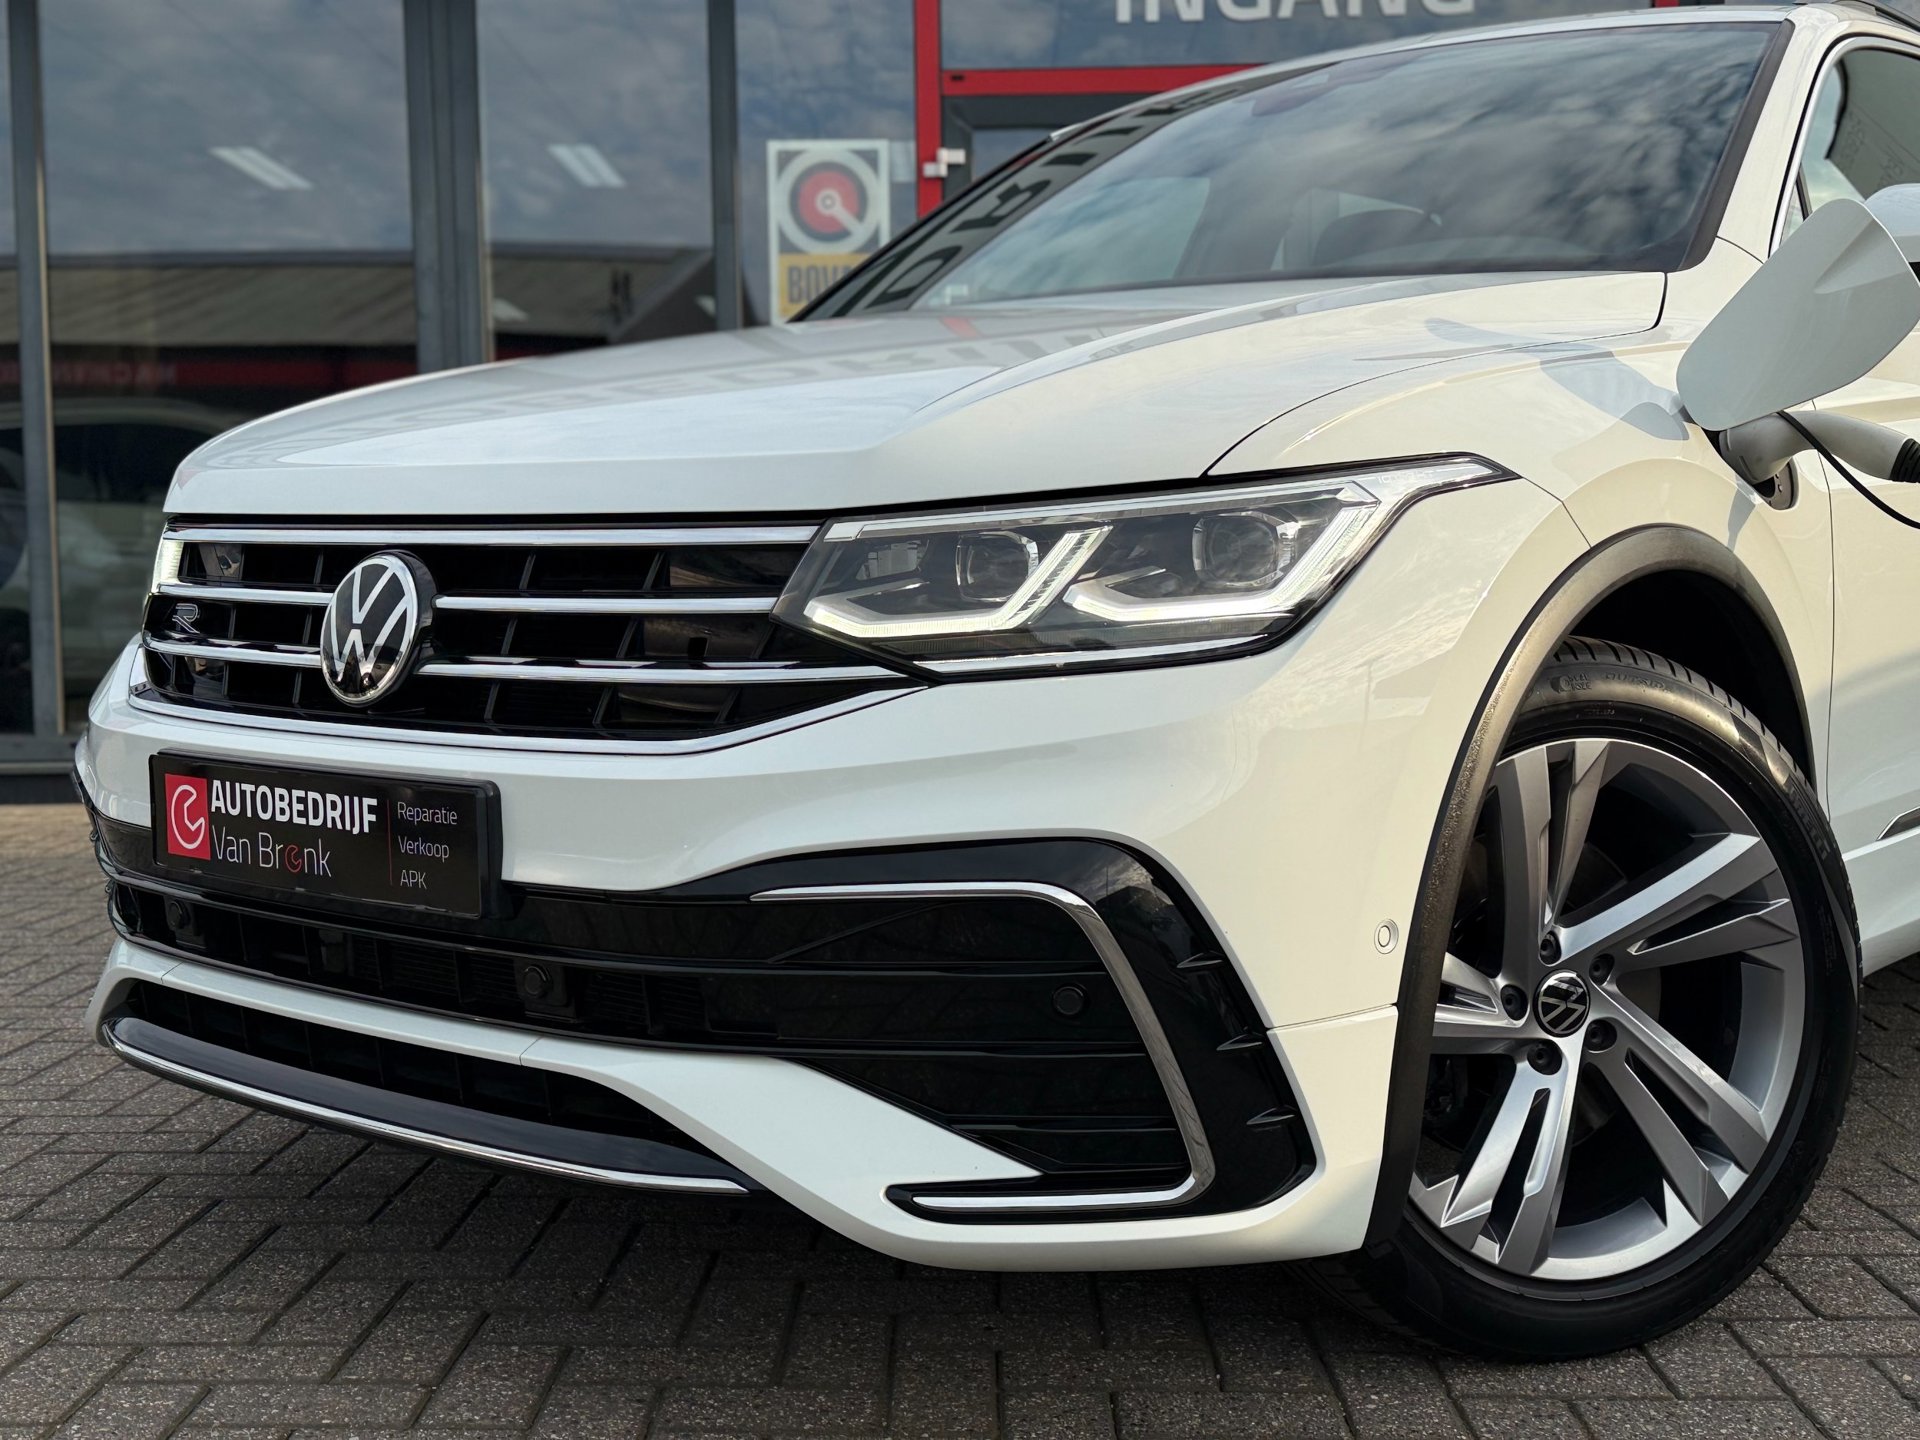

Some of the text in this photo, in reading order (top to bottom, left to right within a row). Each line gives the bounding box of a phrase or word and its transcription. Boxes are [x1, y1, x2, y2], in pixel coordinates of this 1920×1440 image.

[211, 779, 378, 835] AUTOBEDRIJF
[397, 801, 458, 826] Reparatie
[211, 825, 251, 865] Van
[397, 834, 450, 863] Verkoop
[400, 869, 428, 890] APK
